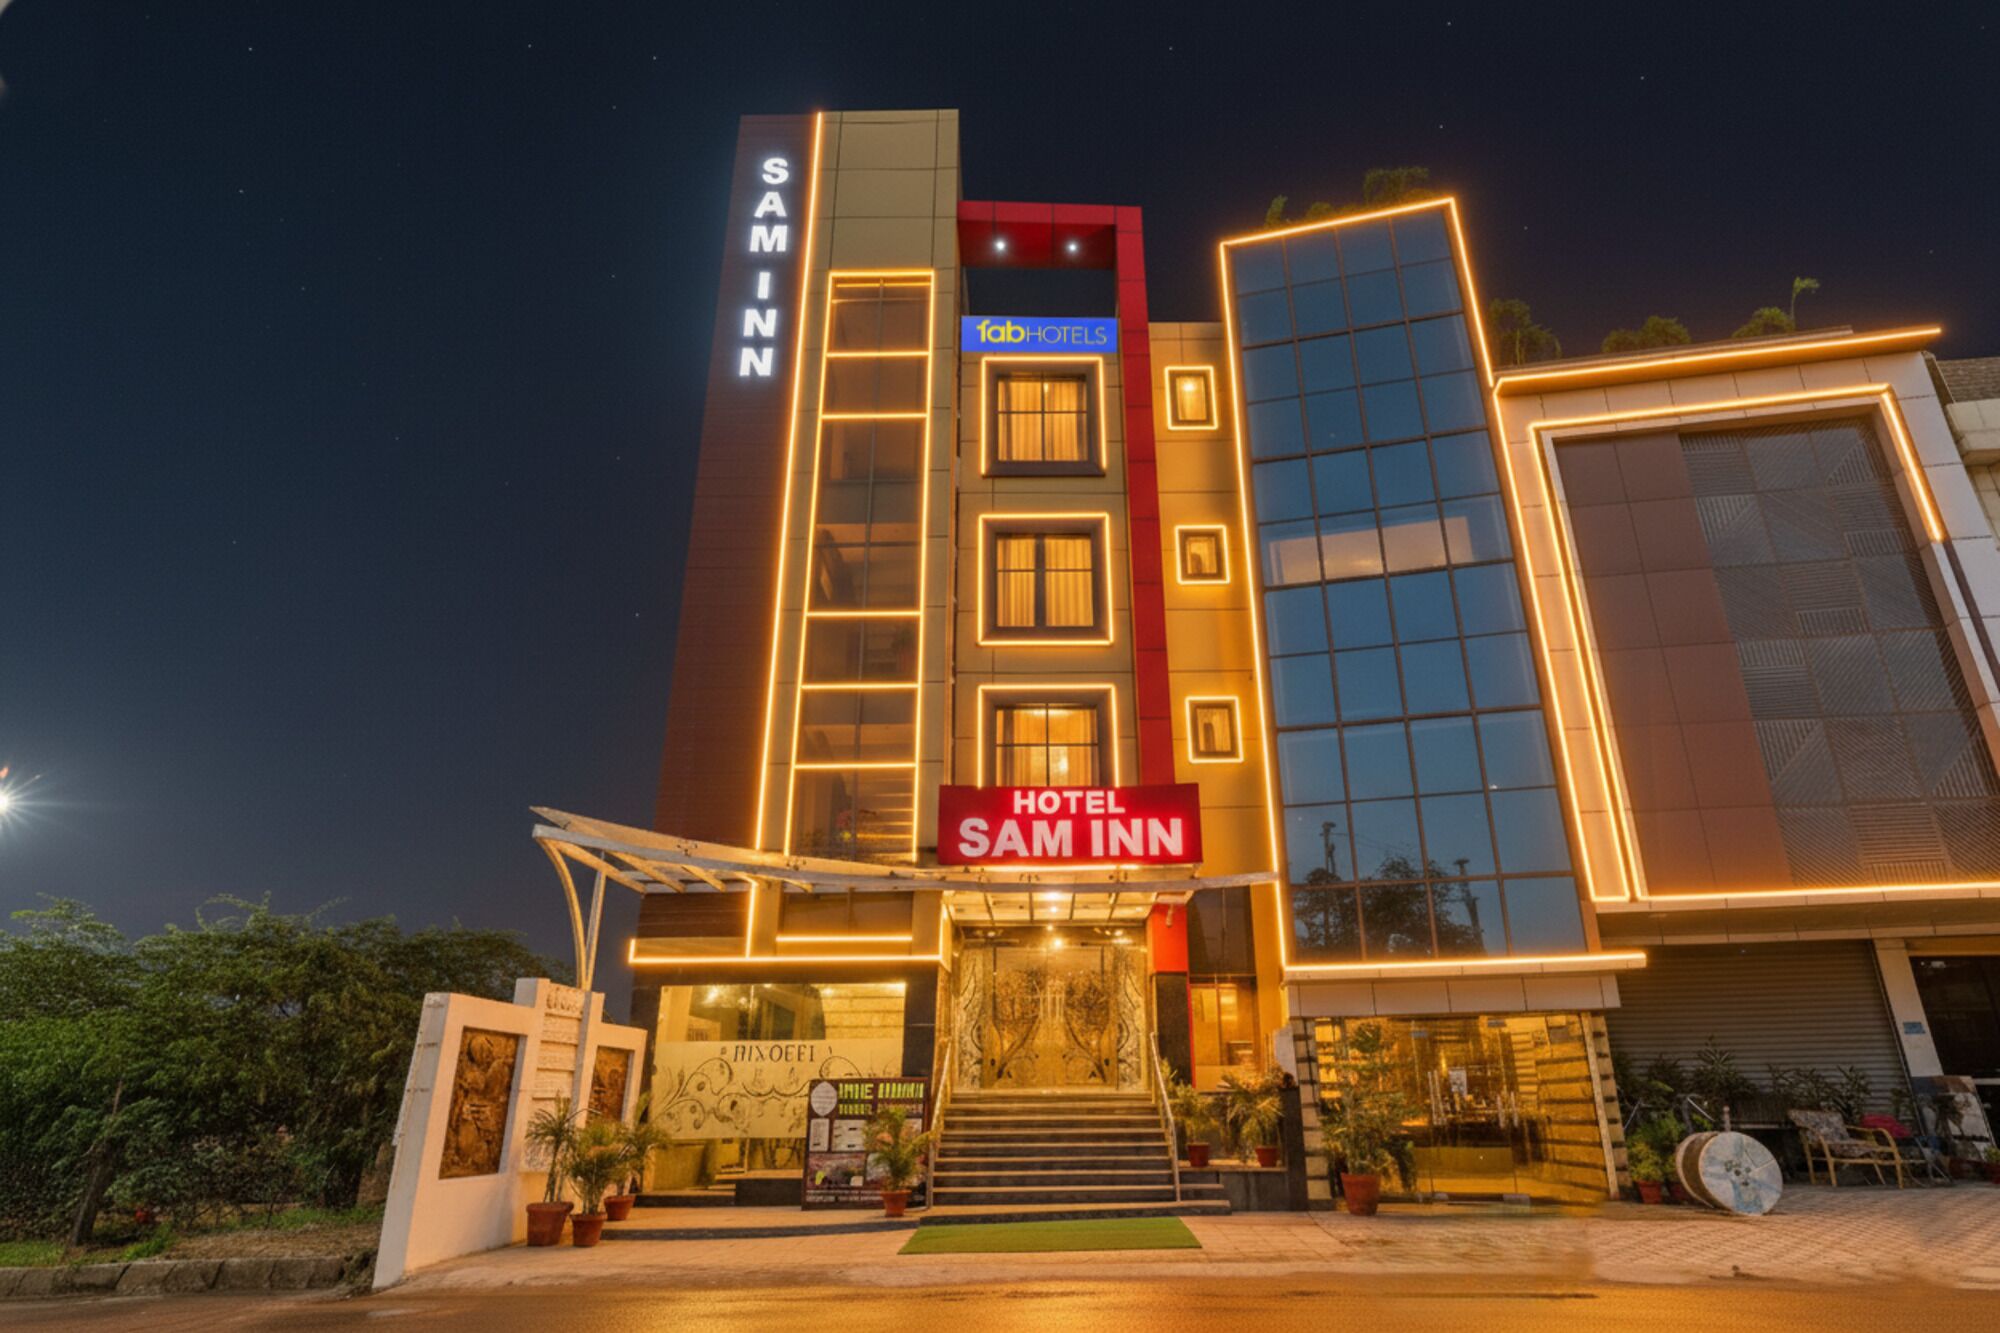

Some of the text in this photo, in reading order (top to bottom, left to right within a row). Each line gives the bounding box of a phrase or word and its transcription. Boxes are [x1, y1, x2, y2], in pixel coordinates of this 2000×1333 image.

[739, 157, 789, 376] SAM INN
[1013, 790, 1126, 814] HOTEL
[958, 818, 1183, 857] SAM INN
